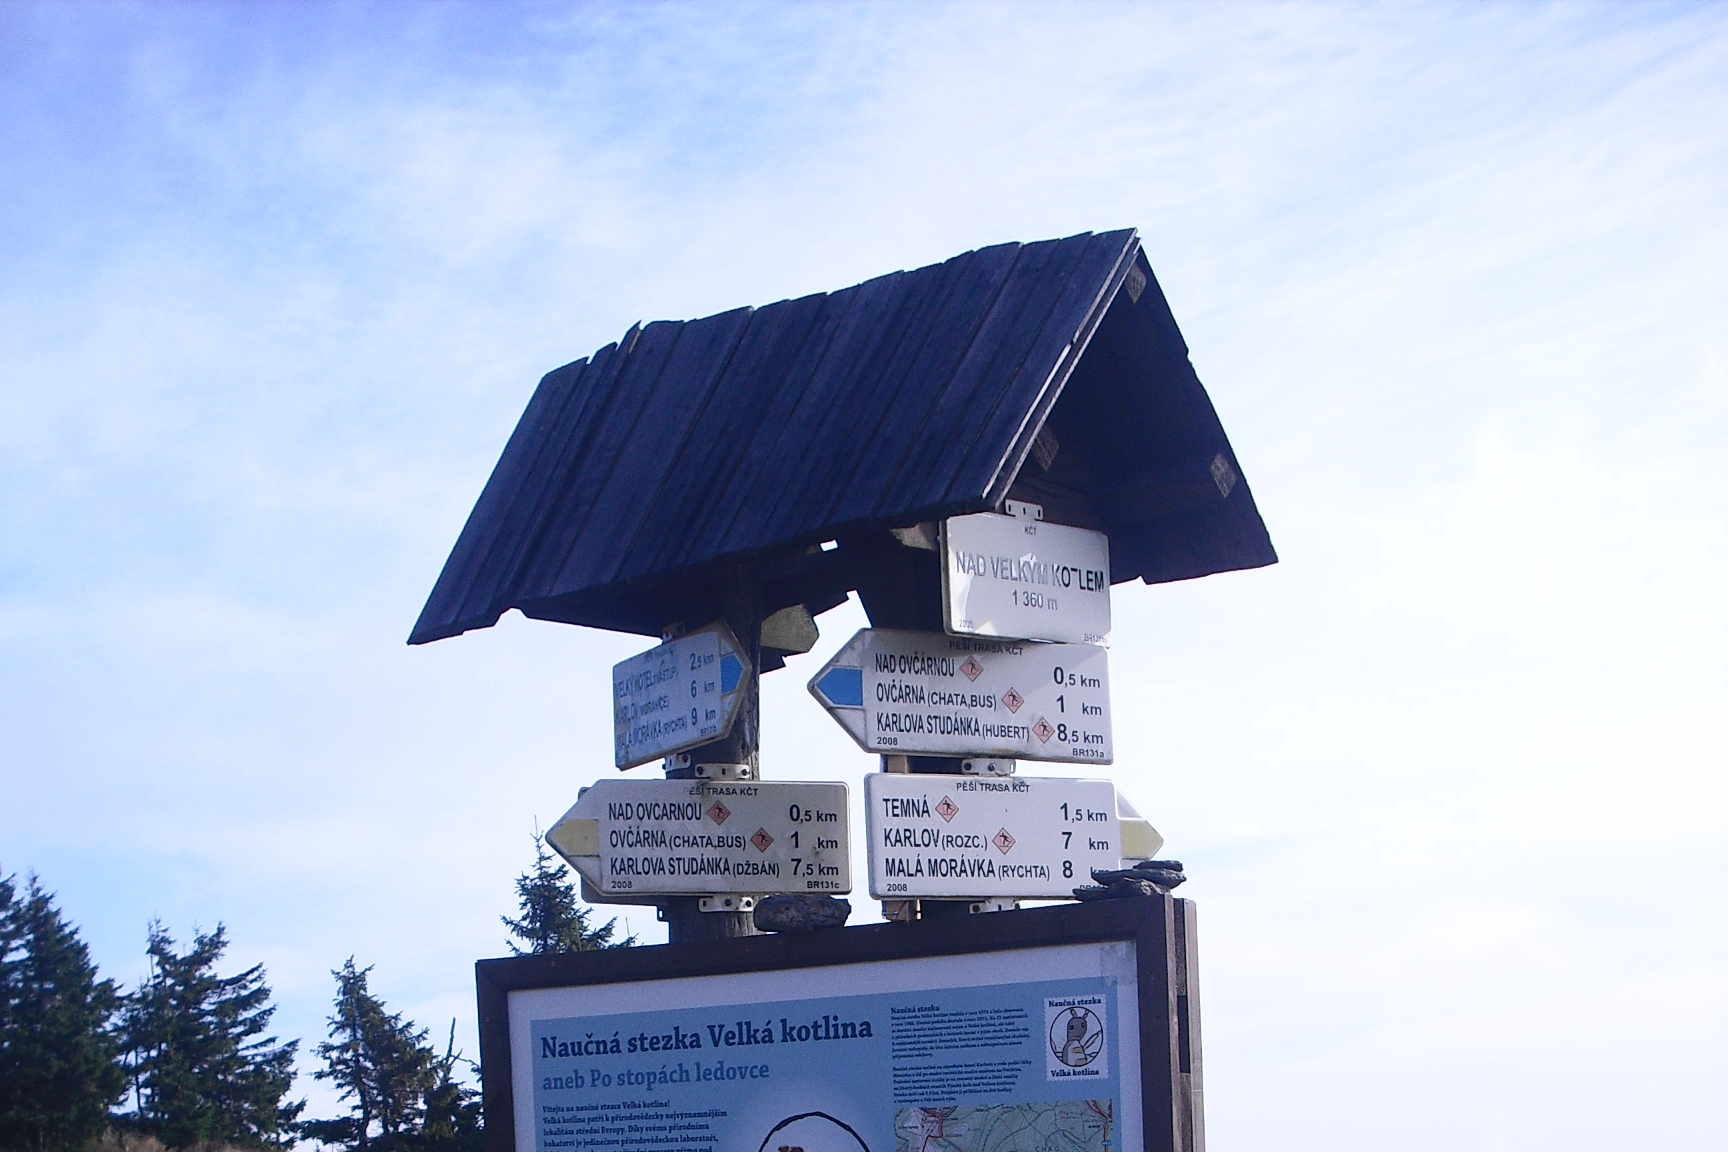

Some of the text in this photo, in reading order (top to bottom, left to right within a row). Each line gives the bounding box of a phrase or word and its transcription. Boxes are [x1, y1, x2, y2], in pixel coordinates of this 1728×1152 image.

[956, 551, 1104, 592] NAD VELKÝM KOLEM
[1012, 589, 1018, 606] 1
[1023, 590, 1043, 608] 360
[974, 643, 1003, 654] TRASA
[875, 652, 1100, 688] NAD OVČÁRNOU 0,5 km
[690, 680, 697, 698] 6
[704, 681, 715, 693] km
[876, 679, 925, 704] OVČÁRNA
[1056, 695, 1065, 713] 1
[1082, 702, 1102, 716] km
[691, 707, 698, 726] 9
[705, 709, 716, 721] km
[877, 711, 1104, 745] KARLOVA STUDÁNKA (HUBERT) 8,5 km
[877, 737, 898, 746] 2008
[706, 787, 738, 796] TRASA
[740, 786, 759, 796] KČT
[956, 781, 1030, 793] PĚŠÍ TRASA KČT
[608, 803, 633, 821] NAD
[789, 804, 812, 824] 0,5
[817, 810, 837, 822] km
[882, 794, 1108, 823] TEMNÁ 1,5 km
[610, 826, 667, 848] OVČÁRNA
[790, 831, 800, 848] 1
[818, 836, 838, 849] km
[1061, 831, 1073, 849] 7
[1088, 838, 1109, 850] km
[610, 853, 839, 878] KARLOVA STUDÁNKA (DŽBÁN) 7,5 km
[885, 854, 924, 878] MALÁ
[928, 854, 996, 878] MORÁVKA
[999, 865, 1050, 881] (RYCHTA)
[1062, 860, 1073, 879] 8
[612, 881, 633, 889] 2008
[887, 884, 908, 892] 2008
[1048, 997, 1101, 1008] Naučná stezka
[541, 1032, 622, 1058] Naučná
[627, 1026, 702, 1053] stezka
[706, 1020, 775, 1048] Velká
[780, 1015, 873, 1044] kotlina
[542, 1060, 770, 1091] aneb Po stopách ledovce
[1051, 1068, 1099, 1077] Velká kotlina
